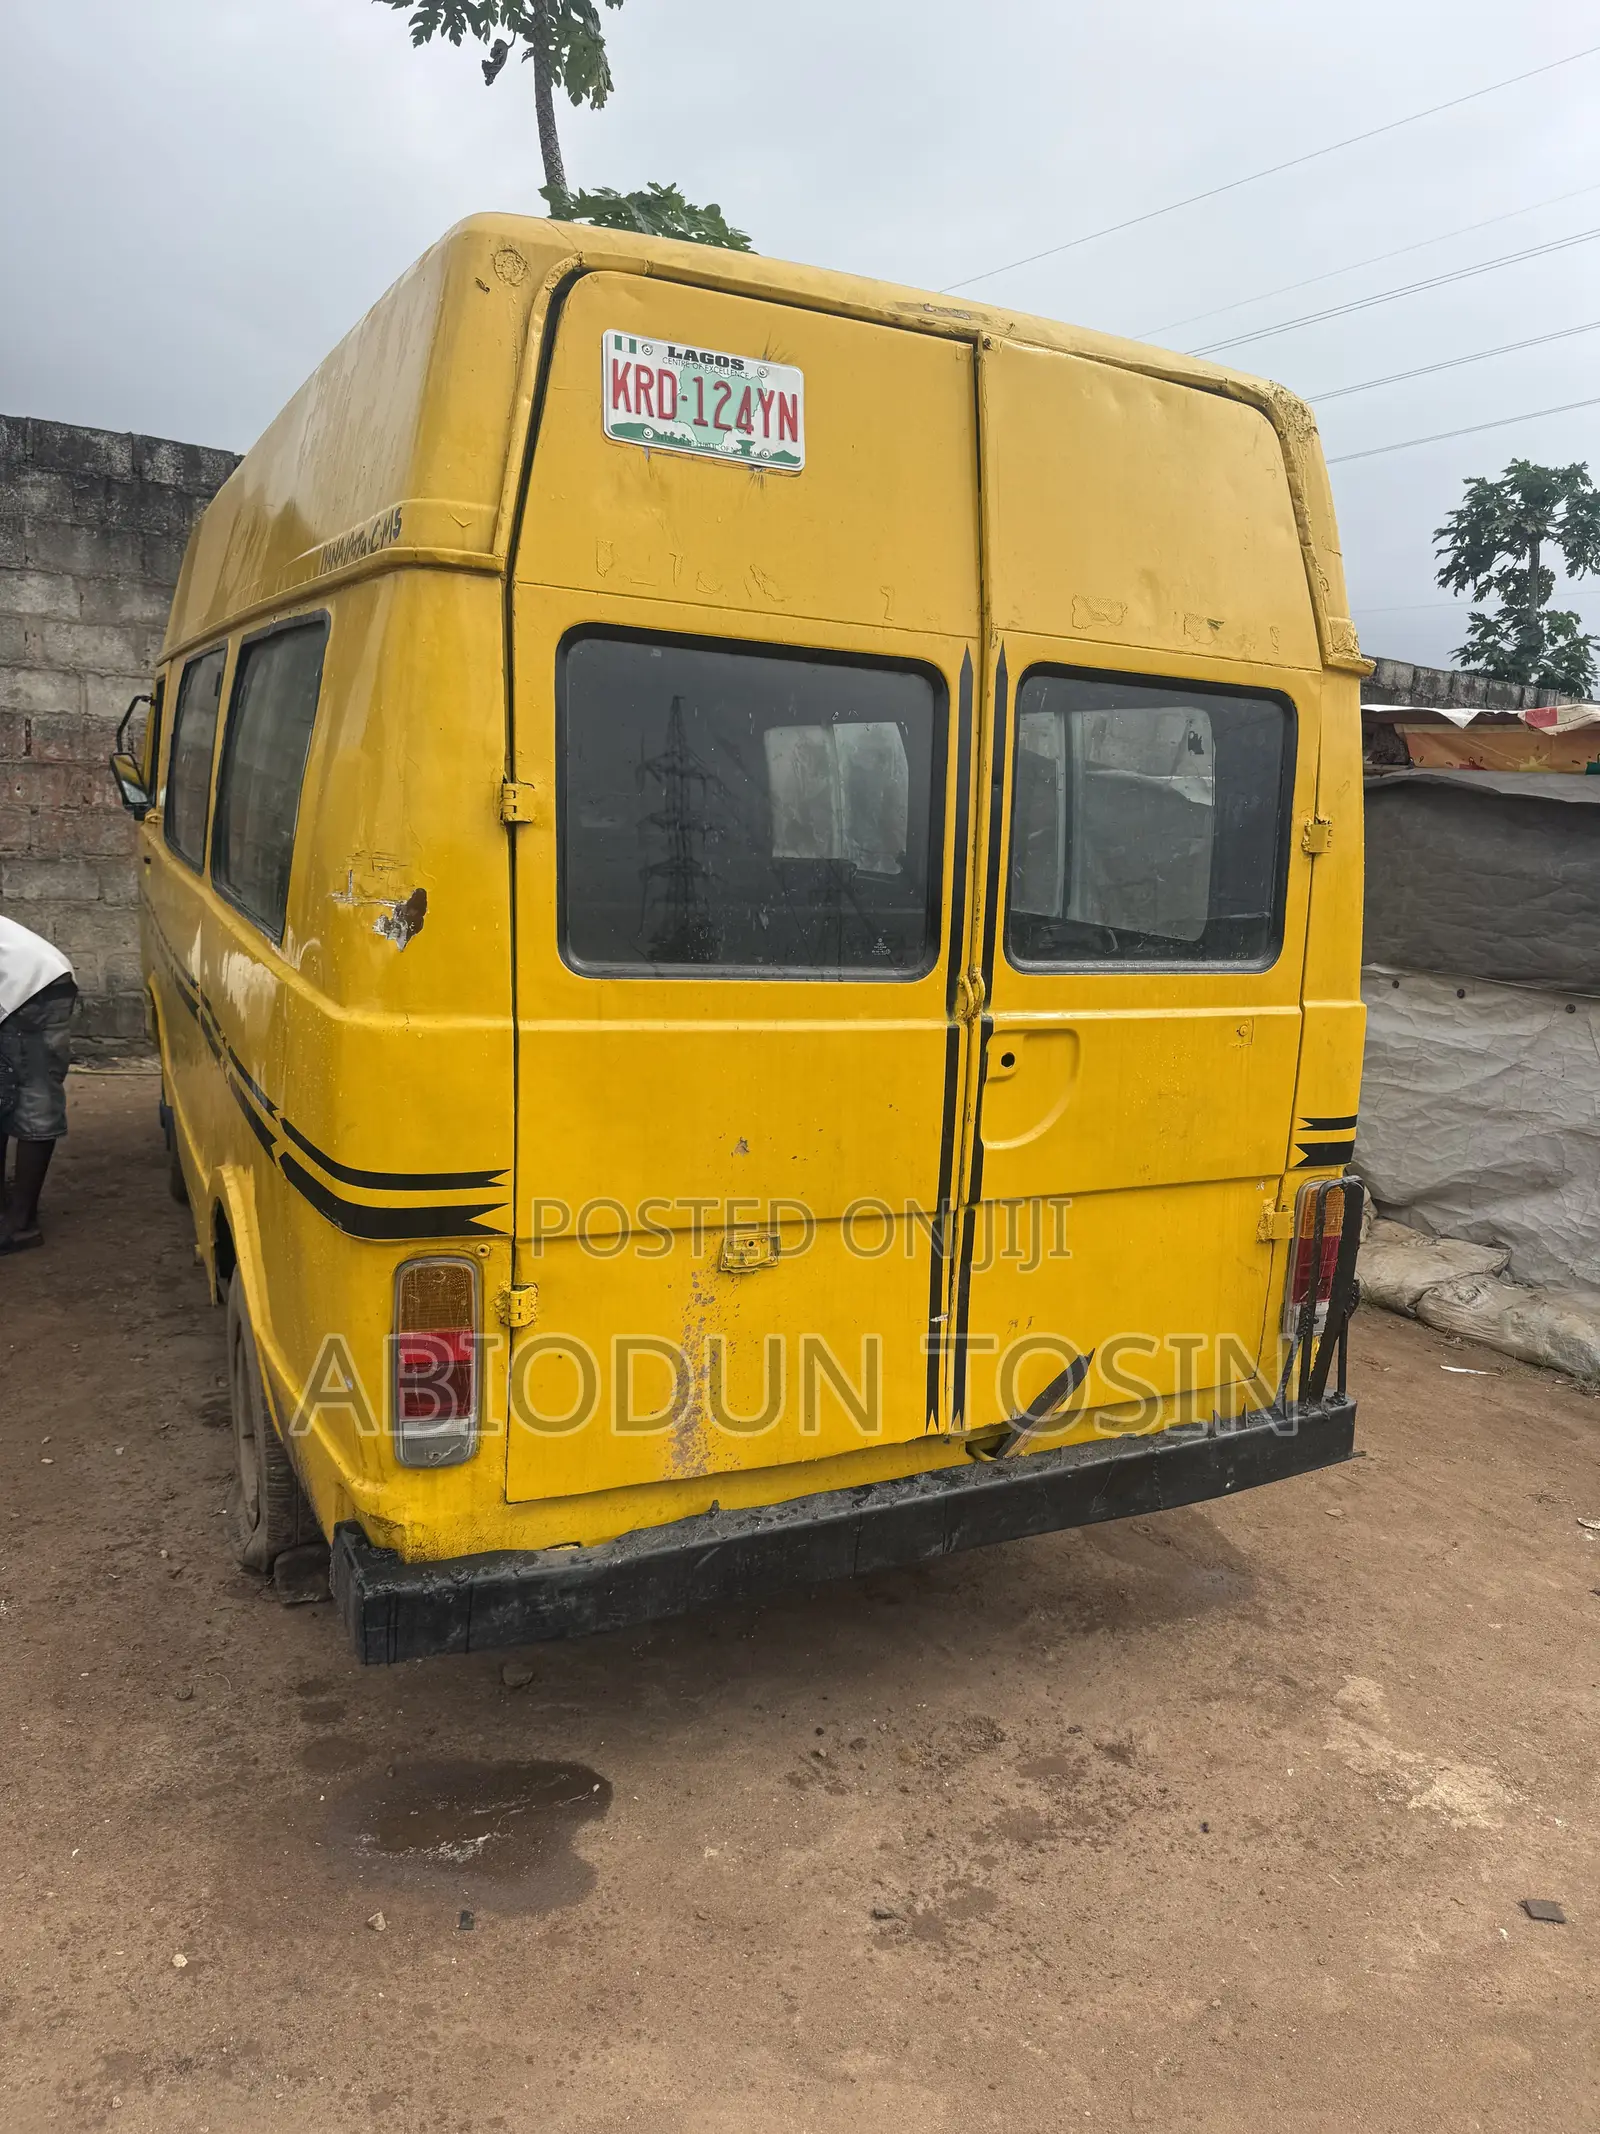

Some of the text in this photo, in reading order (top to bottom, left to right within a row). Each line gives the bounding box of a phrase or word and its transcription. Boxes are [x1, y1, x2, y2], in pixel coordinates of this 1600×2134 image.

[661, 357, 690, 369] CENTRE
[704, 364, 750, 379] EXCELLENCE
[667, 346, 745, 371] LAGOS
[611, 358, 799, 443] KRD-124YN
